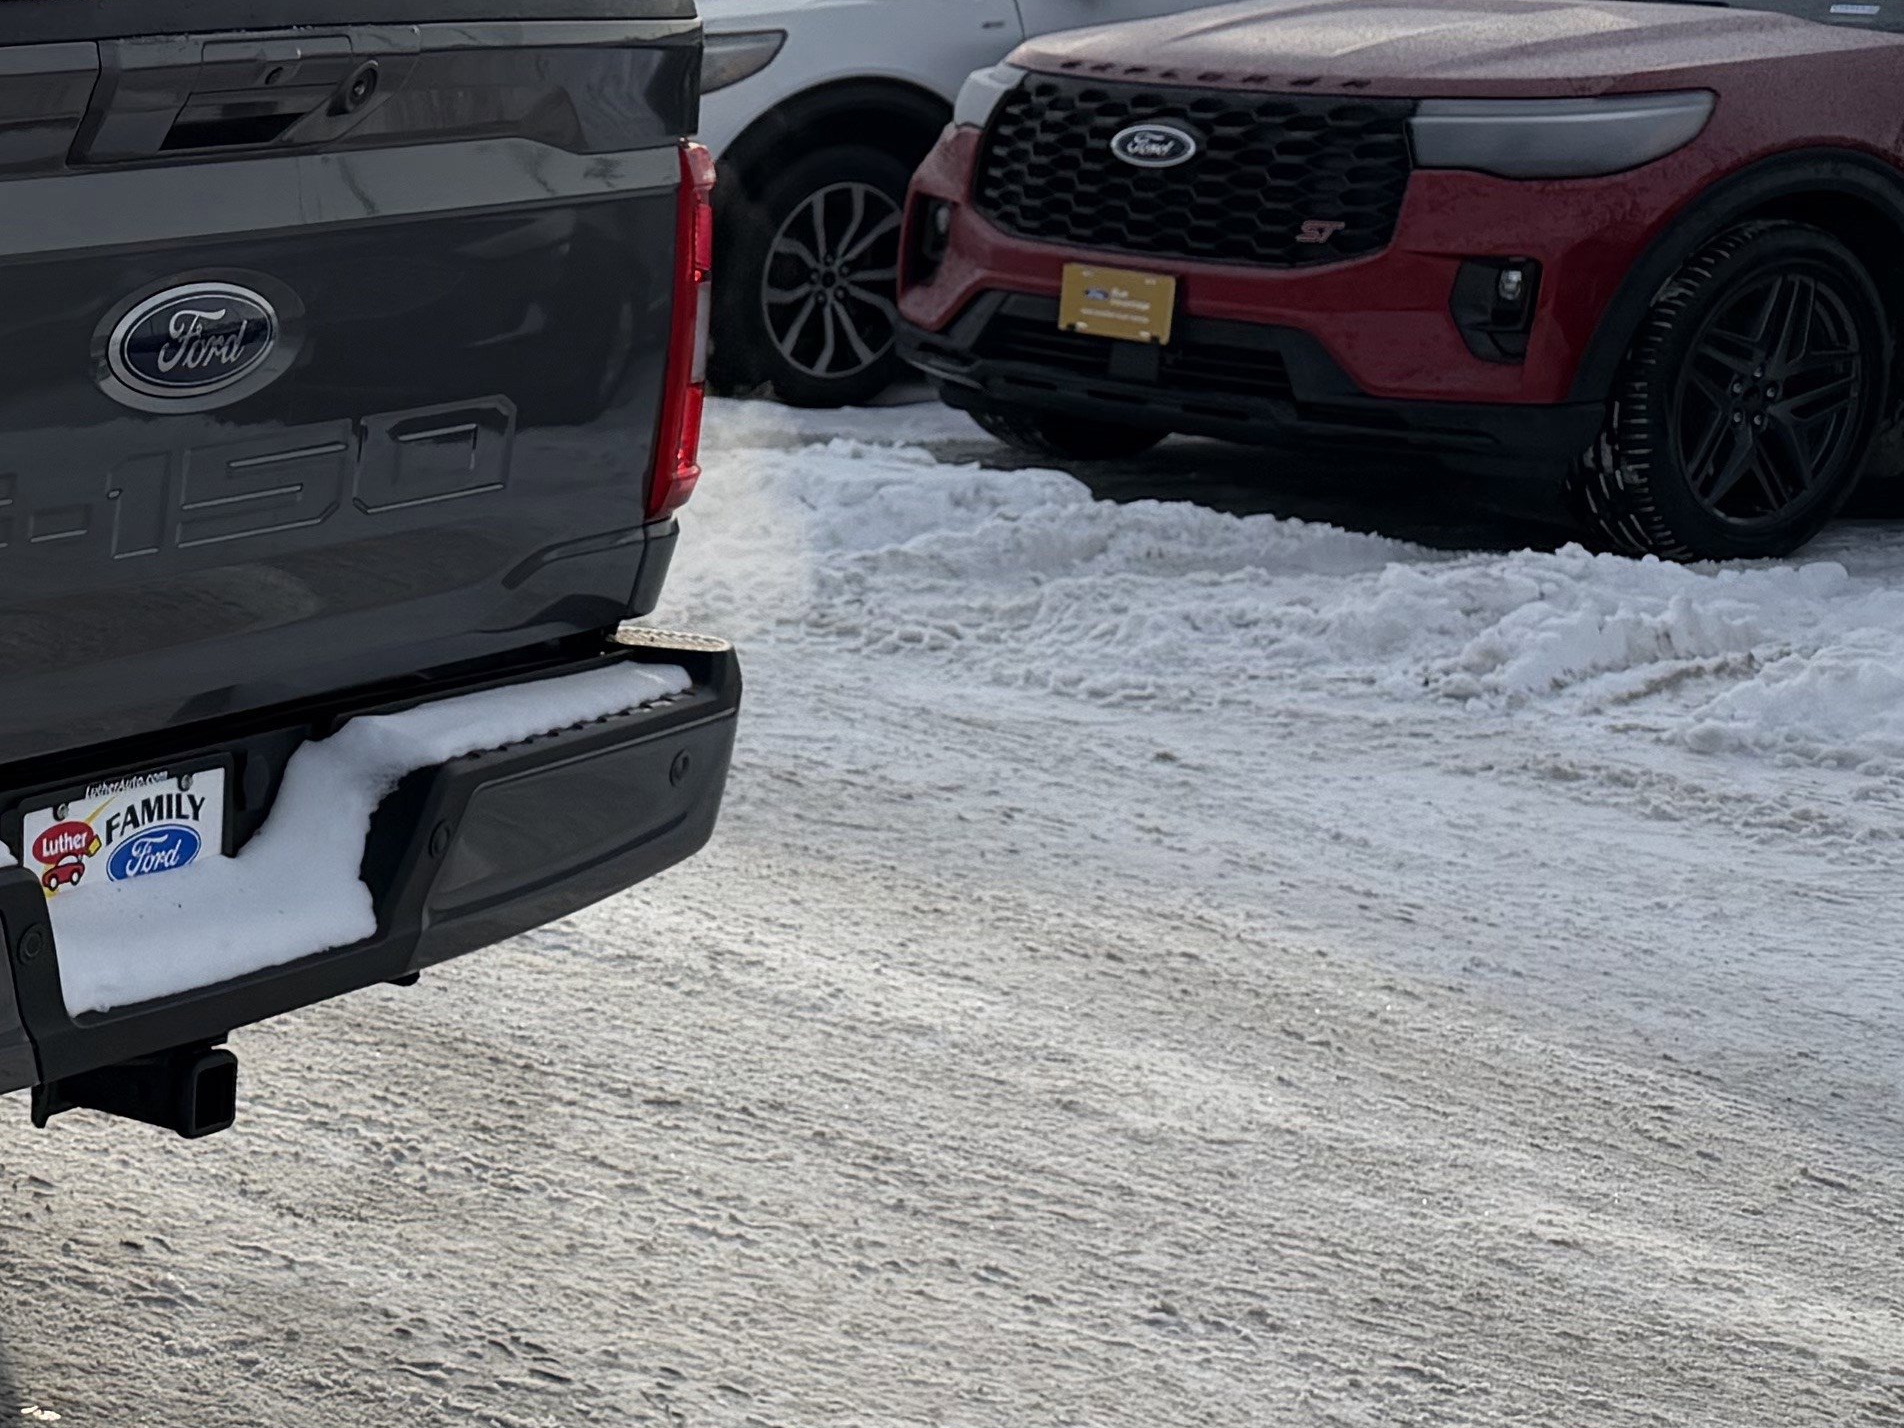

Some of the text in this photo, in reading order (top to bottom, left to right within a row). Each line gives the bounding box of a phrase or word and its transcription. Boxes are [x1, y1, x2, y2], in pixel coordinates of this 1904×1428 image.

[1126, 131, 1176, 157] Ford
[1295, 220, 1346, 244] ST
[158, 308, 248, 373] Ford
[105, 792, 206, 847] FAMILY
[42, 831, 88, 858] Luther
[125, 833, 183, 878] Ford
